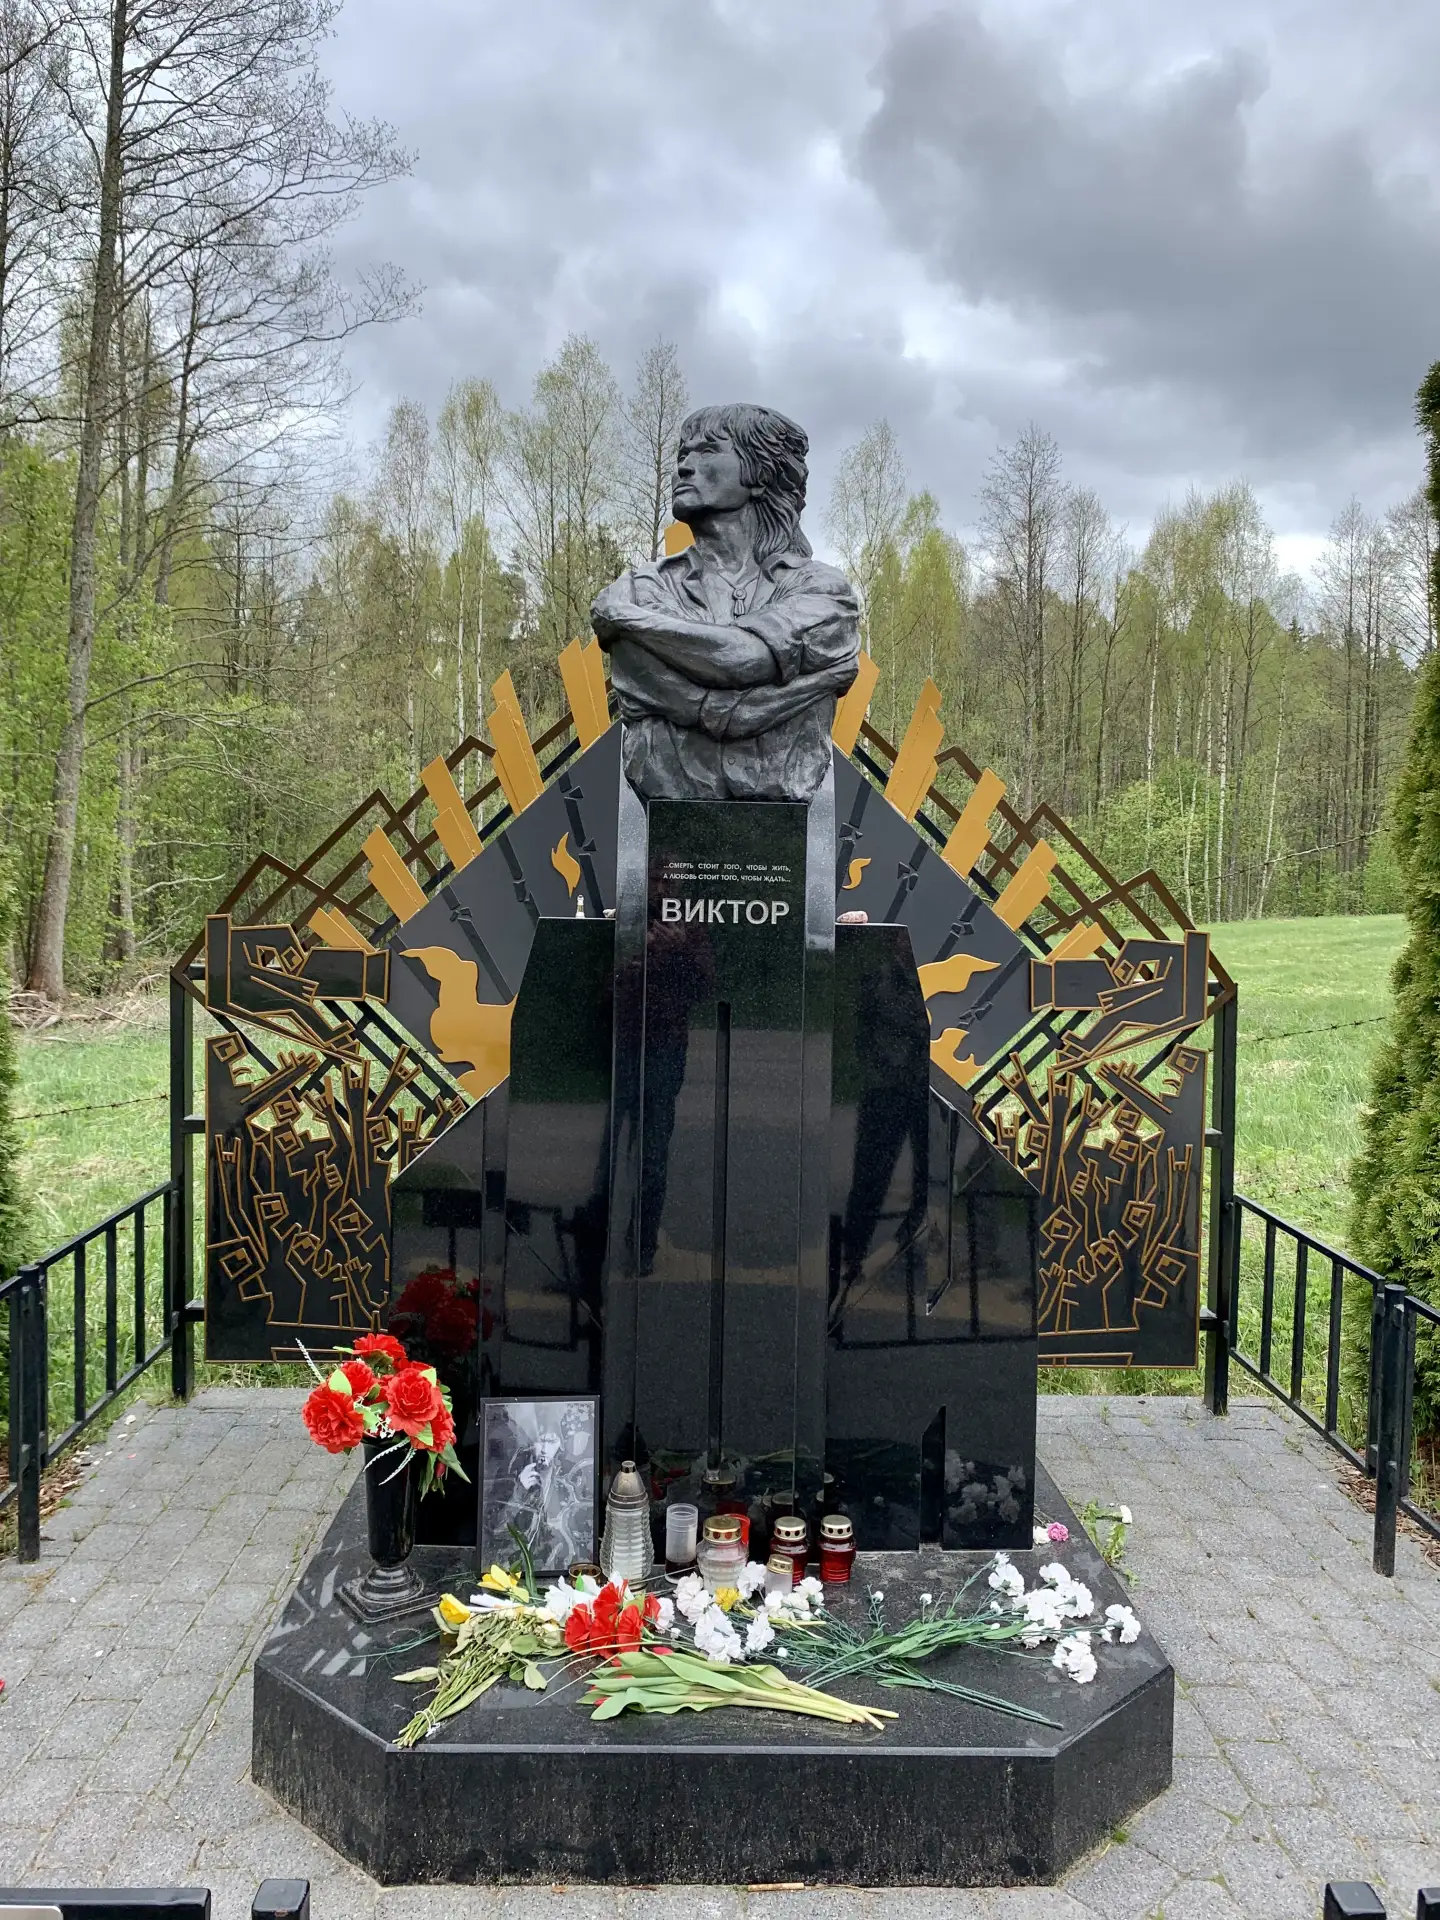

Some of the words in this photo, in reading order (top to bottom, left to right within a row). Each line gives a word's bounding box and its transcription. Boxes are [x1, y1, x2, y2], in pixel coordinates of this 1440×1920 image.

[723, 863, 742, 871] ТОГО,
[721, 874, 740, 882] ТОГО,
[661, 897, 790, 925] ВИКТОР
